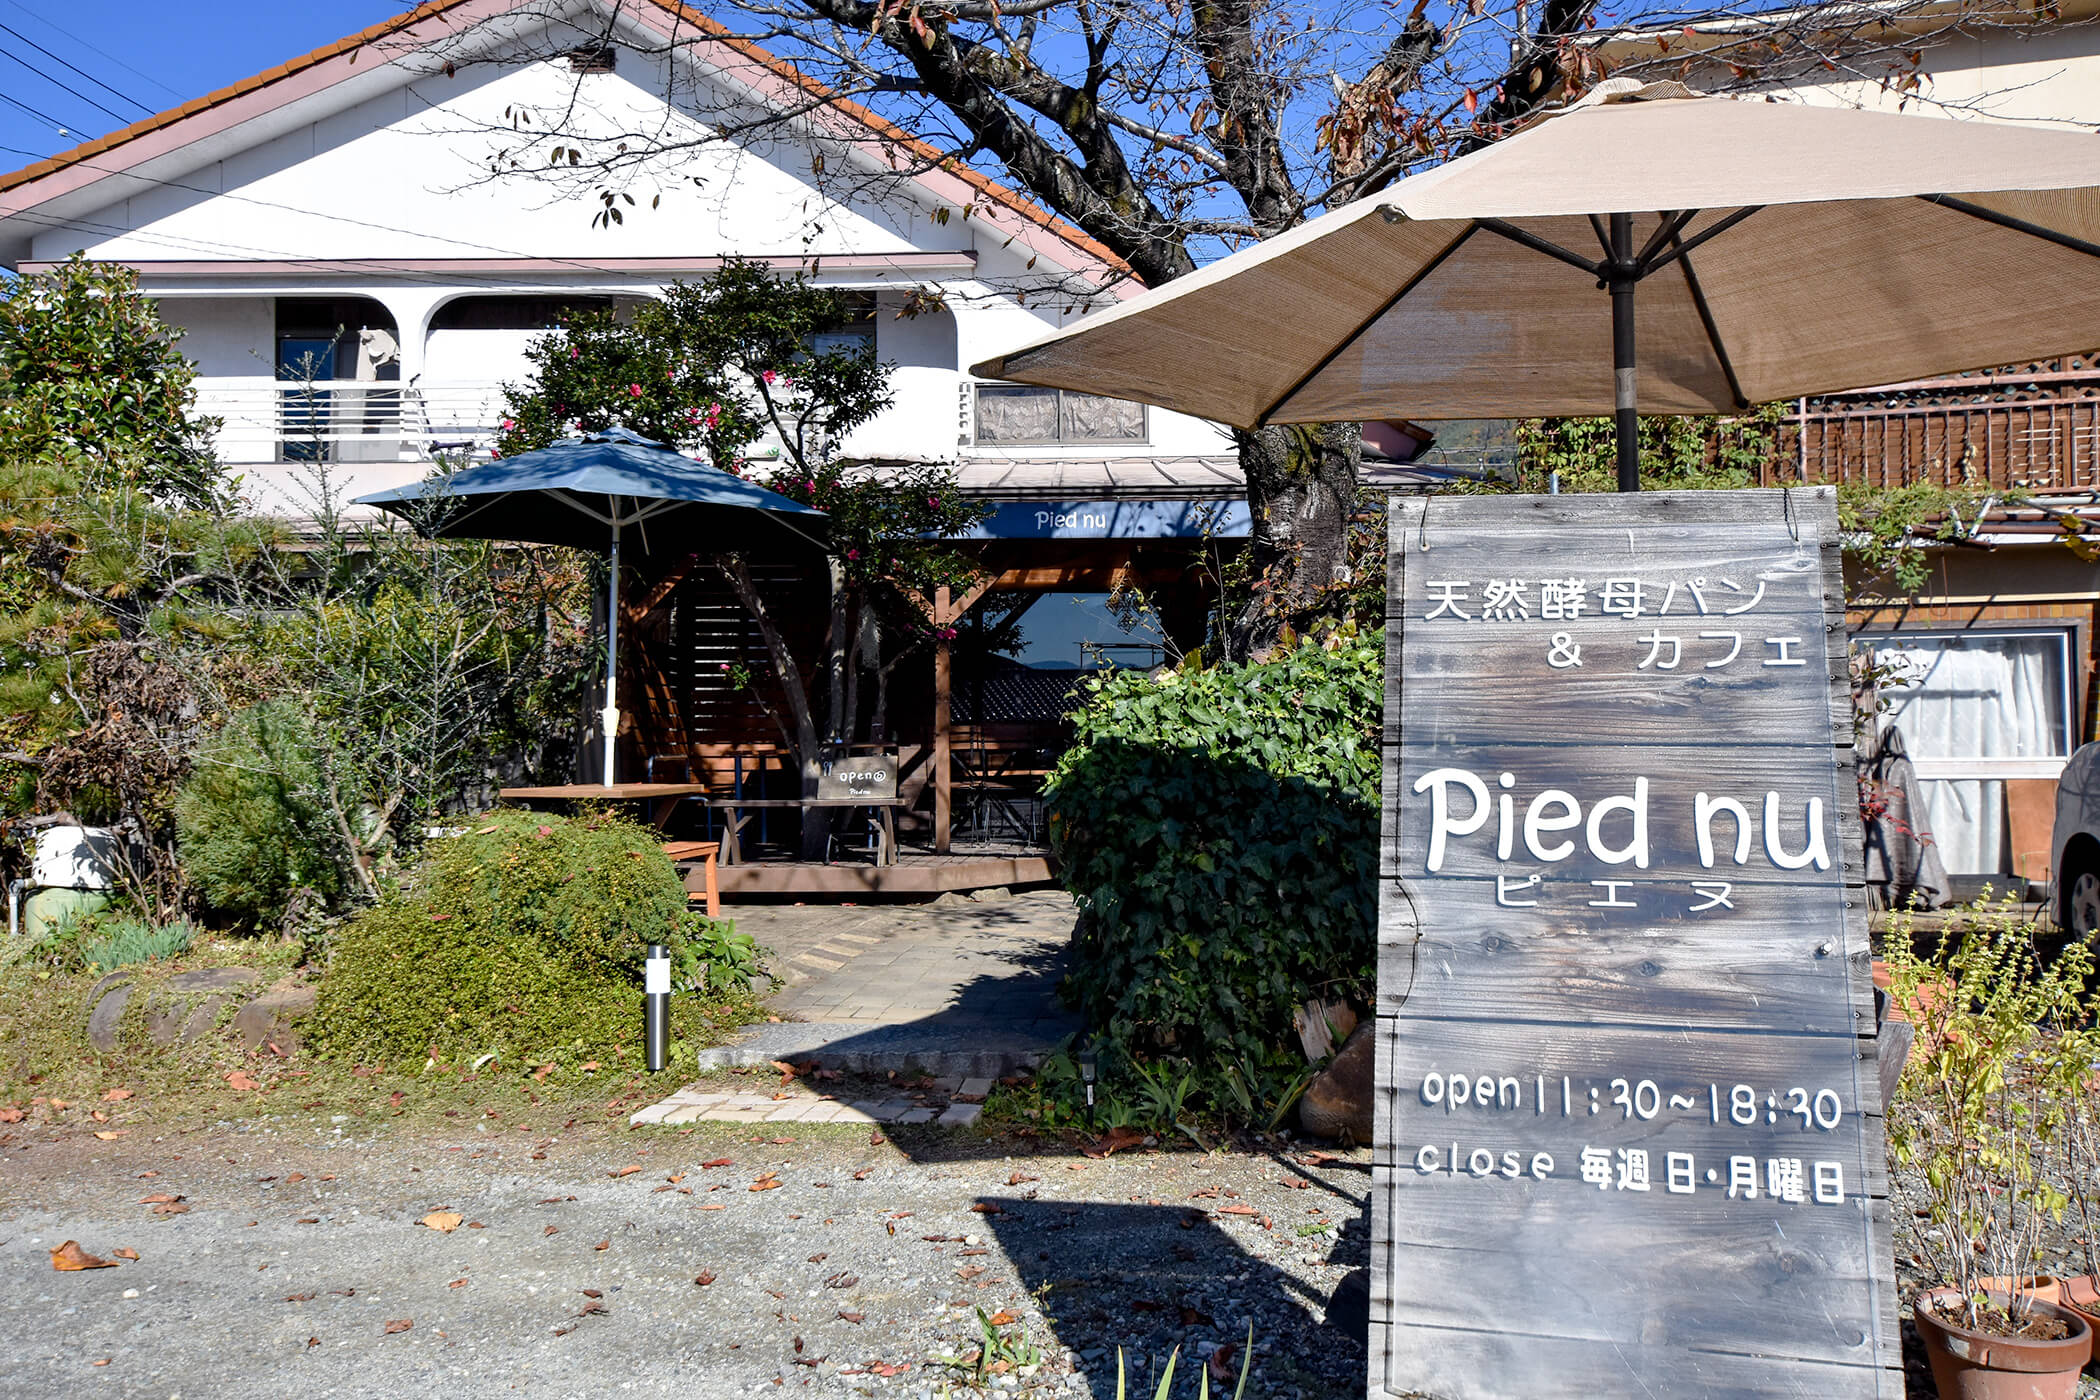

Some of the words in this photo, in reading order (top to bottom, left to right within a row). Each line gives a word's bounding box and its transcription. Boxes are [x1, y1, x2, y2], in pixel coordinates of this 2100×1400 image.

[1034, 511, 1077, 530] Pied
[1082, 514, 1107, 529] nu
[1424, 578, 1766, 620] 天然酵母パン
[1547, 632, 1583, 668] &
[1637, 629, 1807, 668] カフェ
[840, 771, 873, 784] open
[1412, 768, 1650, 872] Pied
[1694, 791, 1831, 870] nu
[1497, 873, 1736, 912] ピエヌ
[1417, 1142, 1555, 1179] close
